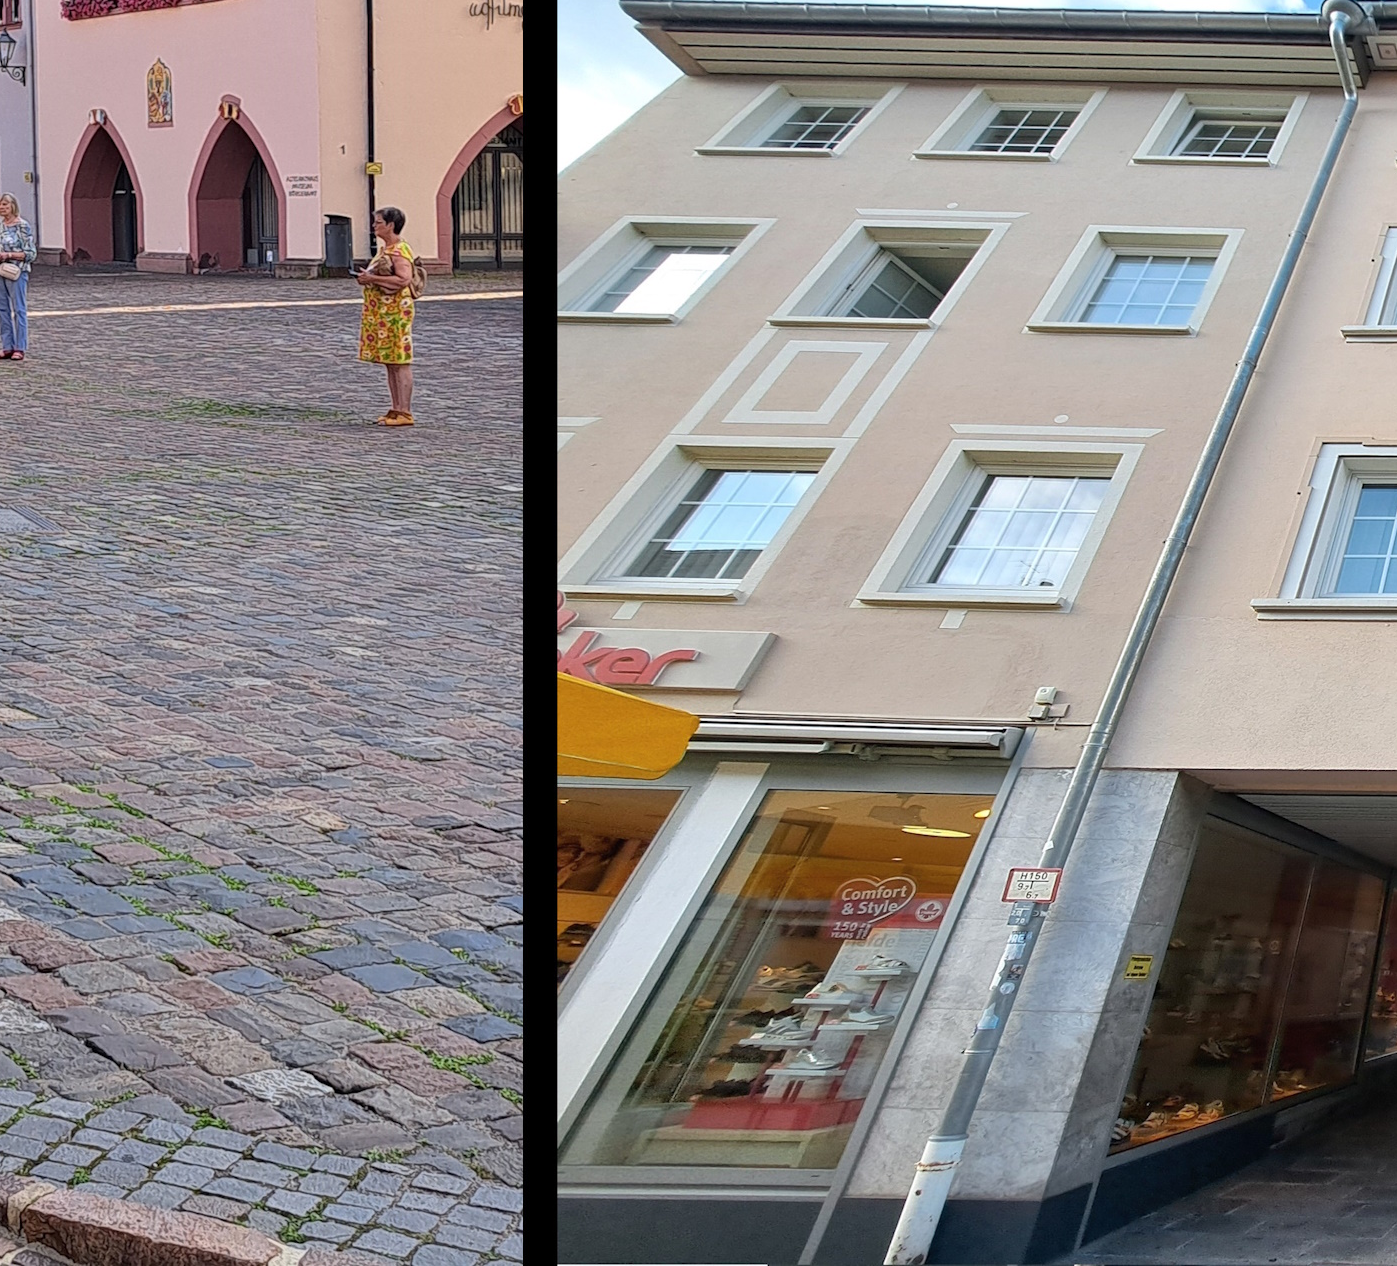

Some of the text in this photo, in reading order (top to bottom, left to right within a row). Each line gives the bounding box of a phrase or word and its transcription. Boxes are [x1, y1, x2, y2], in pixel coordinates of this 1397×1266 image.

[557, 631, 699, 685] ker
[841, 885, 908, 902] Comfort
[841, 900, 899, 916] & Style
[833, 921, 858, 932] 150
